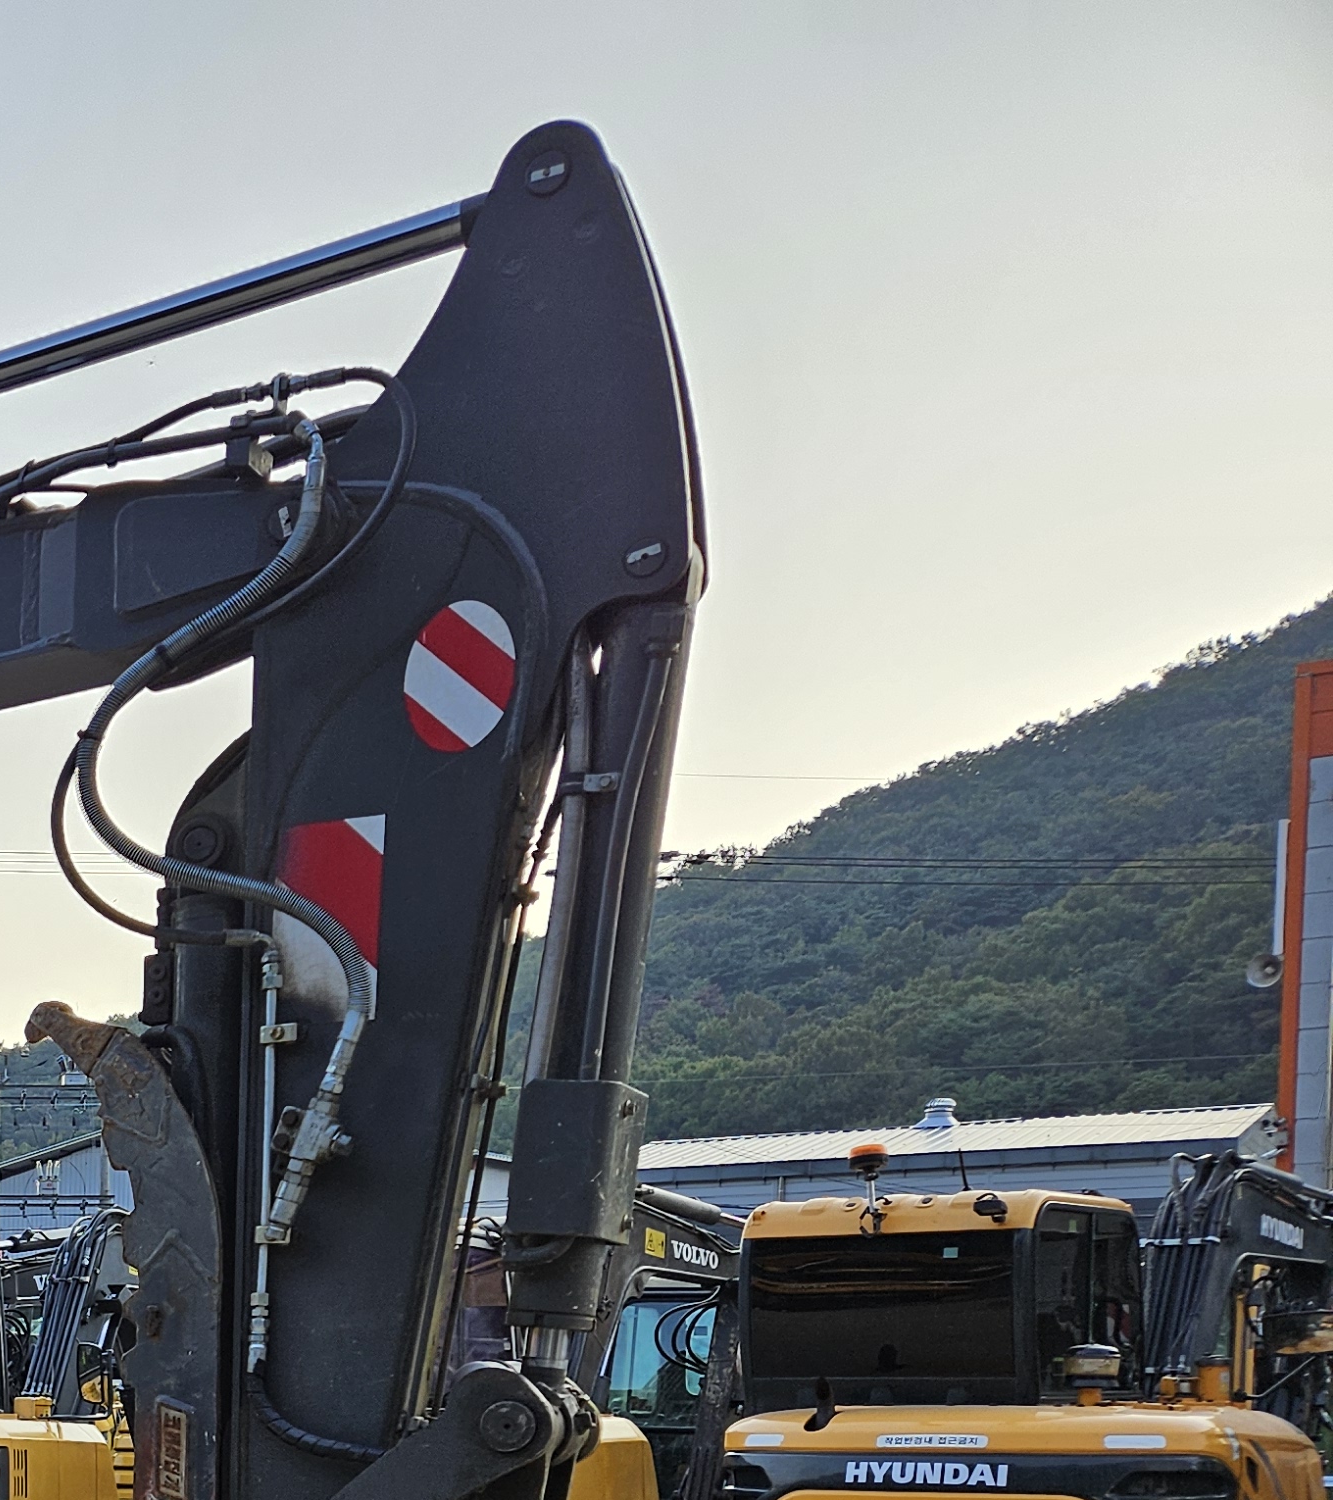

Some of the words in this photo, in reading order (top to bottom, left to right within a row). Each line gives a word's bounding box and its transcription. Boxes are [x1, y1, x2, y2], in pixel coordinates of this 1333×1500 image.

[671, 1239, 719, 1269] VOLVO
[884, 1436, 933, 1445] 작업반경내
[938, 1436, 979, 1445] 접근금지
[845, 1461, 1009, 1487] HYUNDAI
